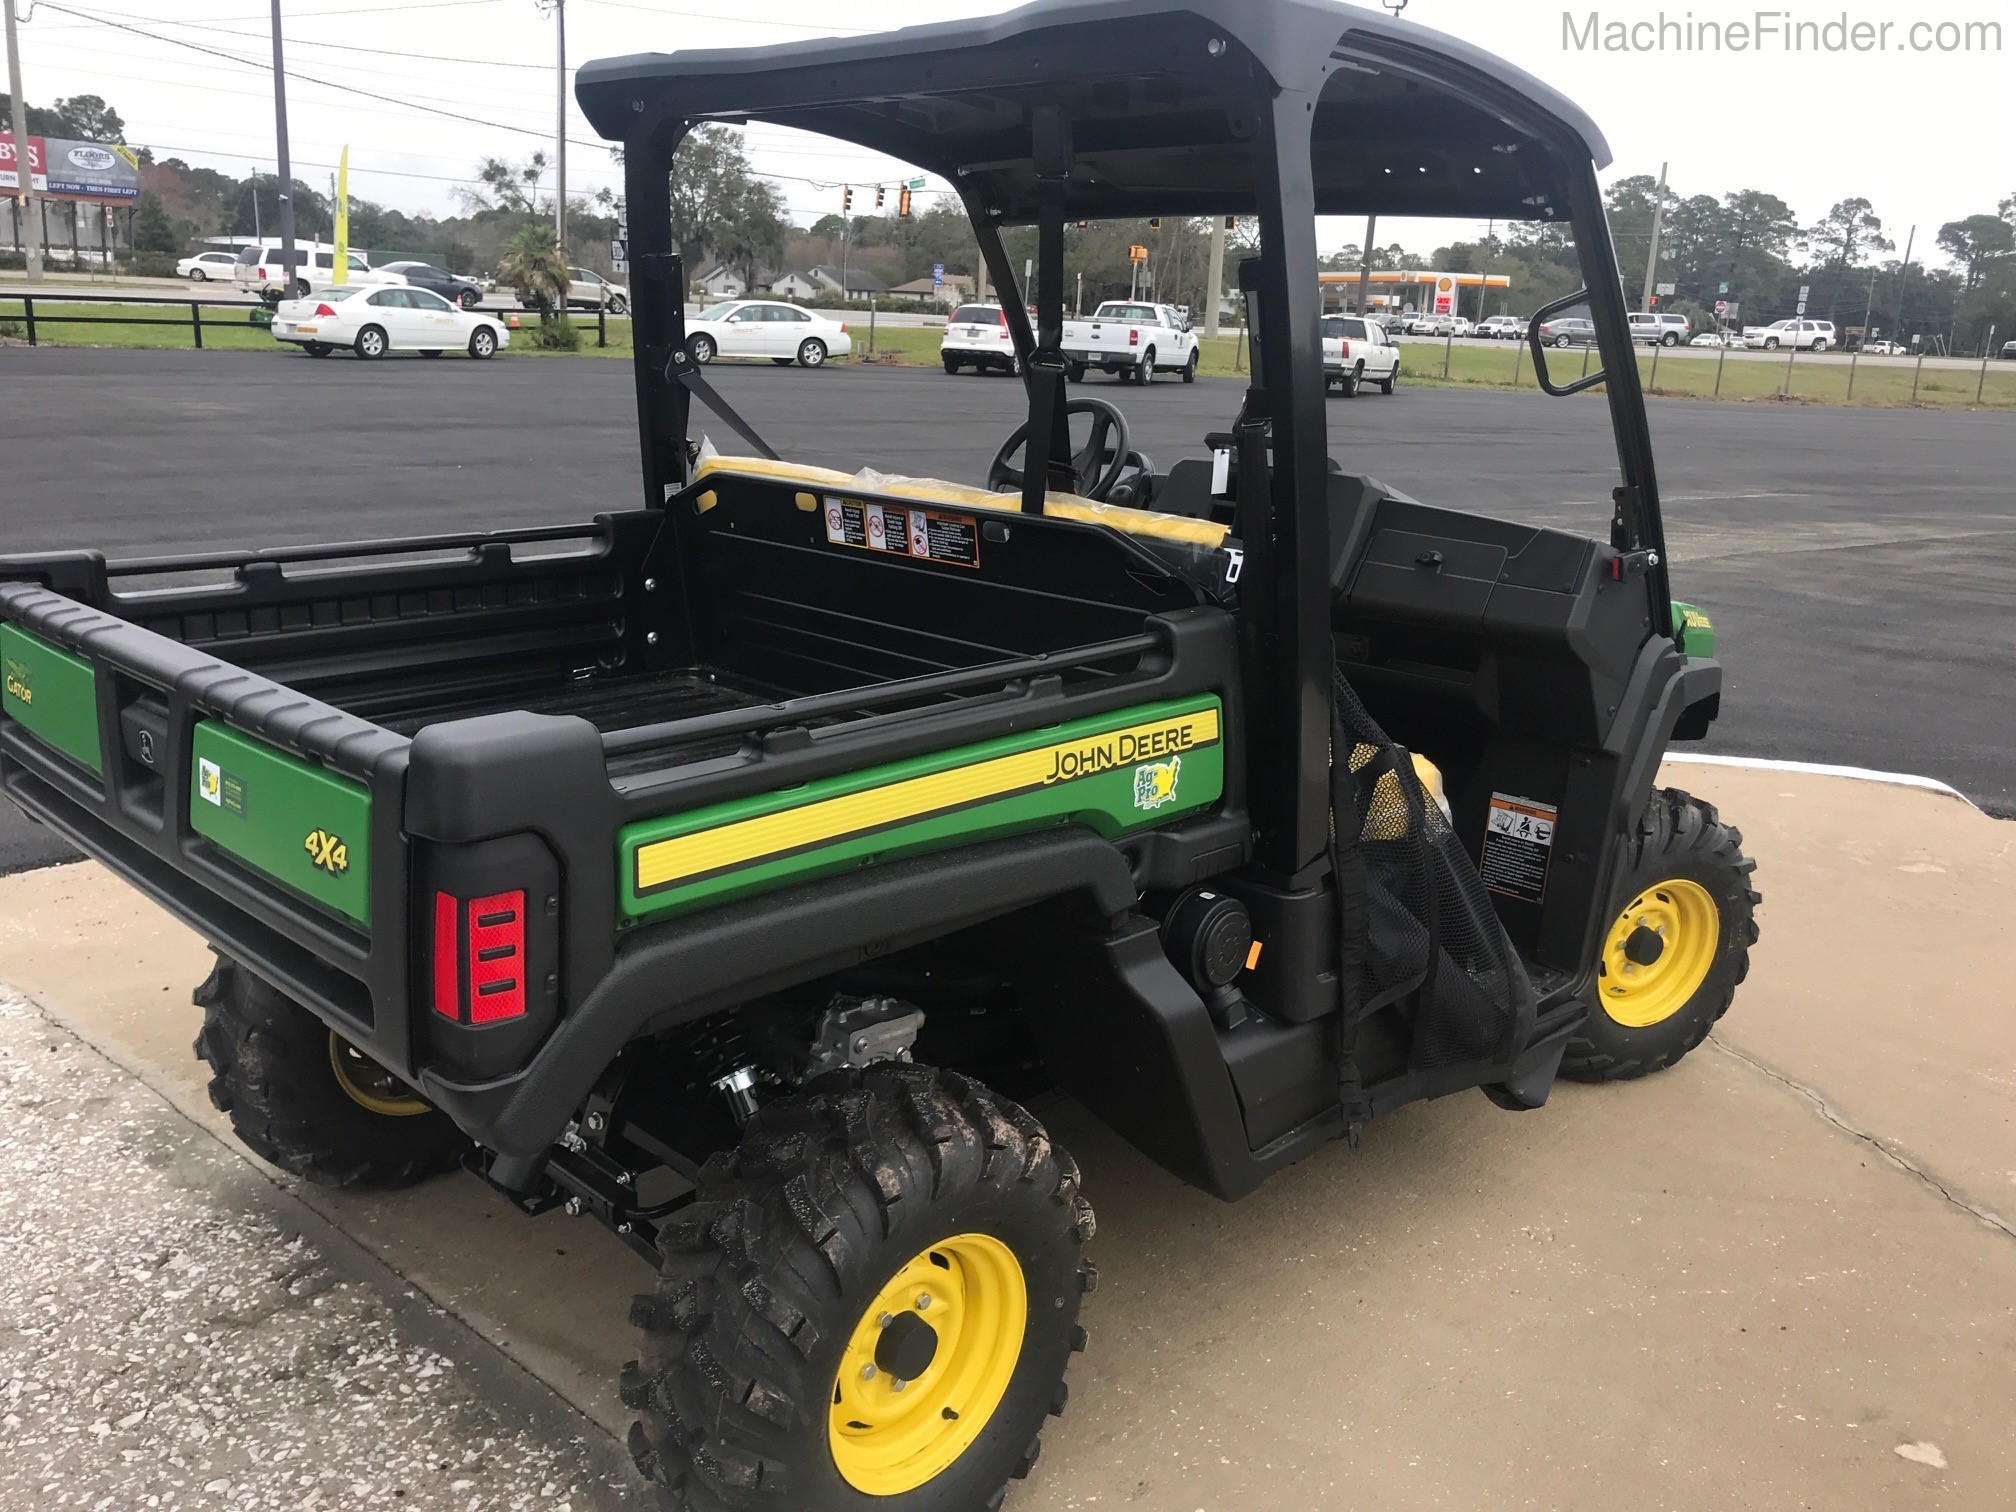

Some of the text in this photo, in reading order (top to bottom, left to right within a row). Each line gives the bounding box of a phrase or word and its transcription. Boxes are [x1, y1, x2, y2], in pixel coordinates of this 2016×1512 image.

[74, 150, 110, 160] FLOORS
[48, 182, 65, 190] LEFT
[86, 185, 103, 193] THEN
[104, 187, 121, 195] FIRST
[7, 674, 32, 705] GATOR
[1046, 725, 1193, 780] JOHN DEERE
[1138, 769, 1158, 788] Ag-
[1137, 785, 1158, 803] Pro
